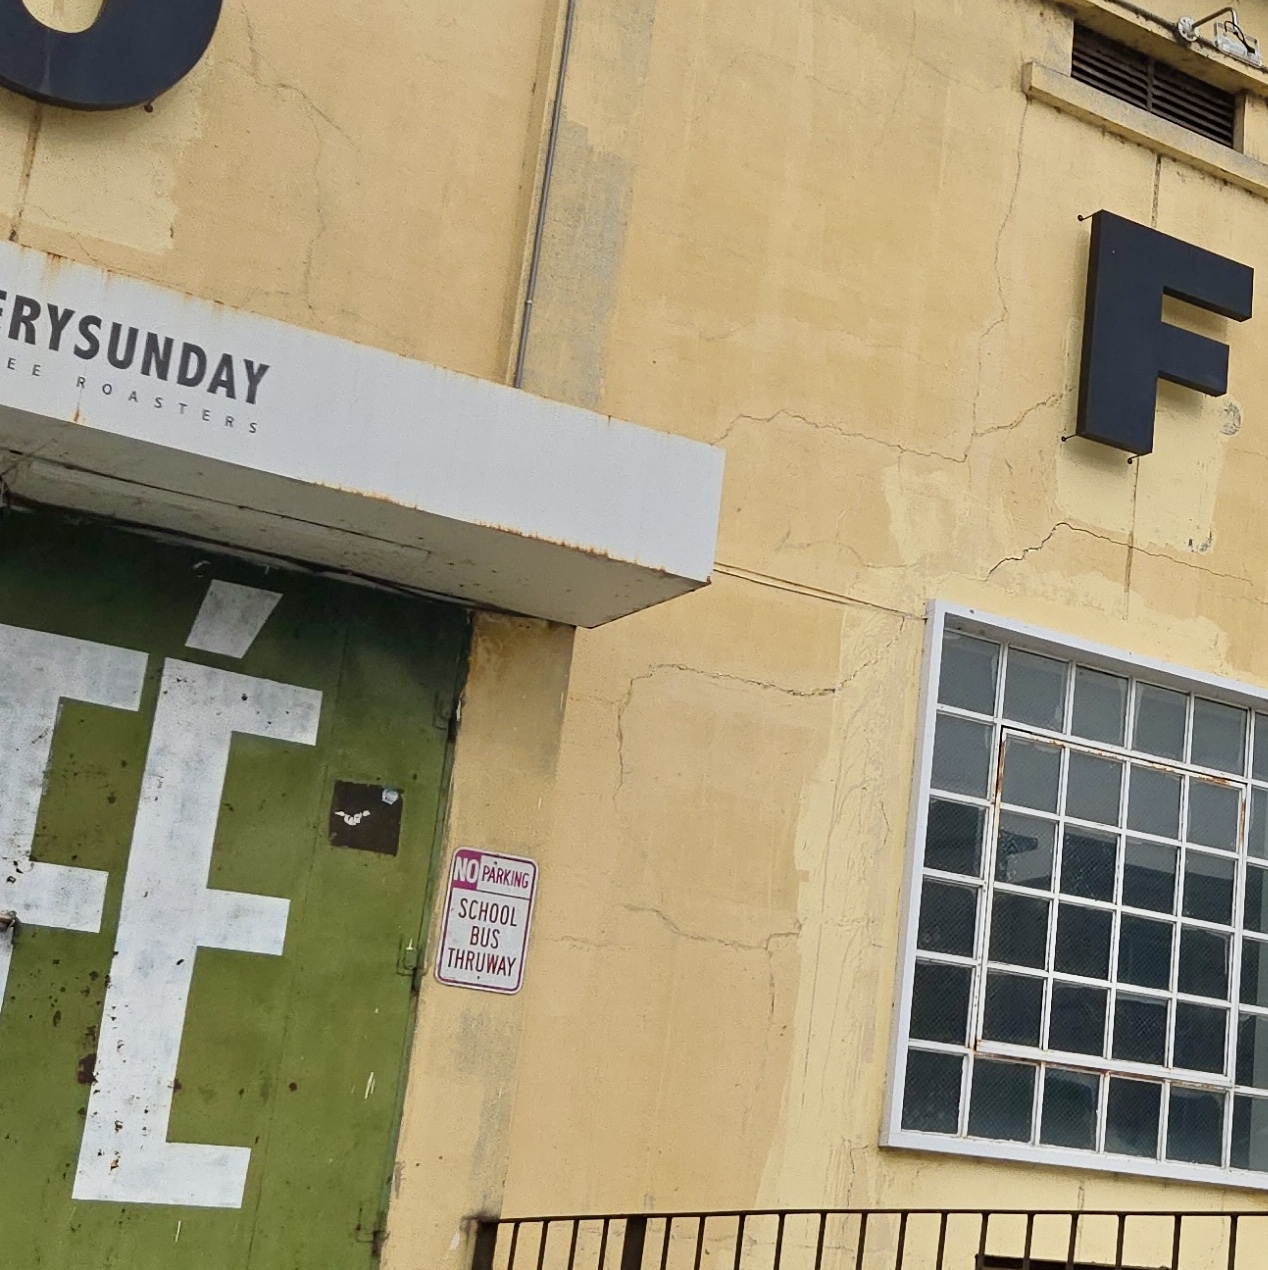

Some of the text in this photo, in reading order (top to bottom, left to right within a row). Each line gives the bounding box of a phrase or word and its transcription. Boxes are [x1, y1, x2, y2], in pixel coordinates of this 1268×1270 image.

[0, 290, 271, 405] RYSUNDAY
[1076, 209, 1254, 456] F
[76, 376, 258, 433] ROASTERS
[453, 856, 530, 889] NO PARKING
[458, 897, 518, 927] SCHOOL
[469, 925, 501, 949] BUS
[447, 947, 517, 977] THRUWAY
